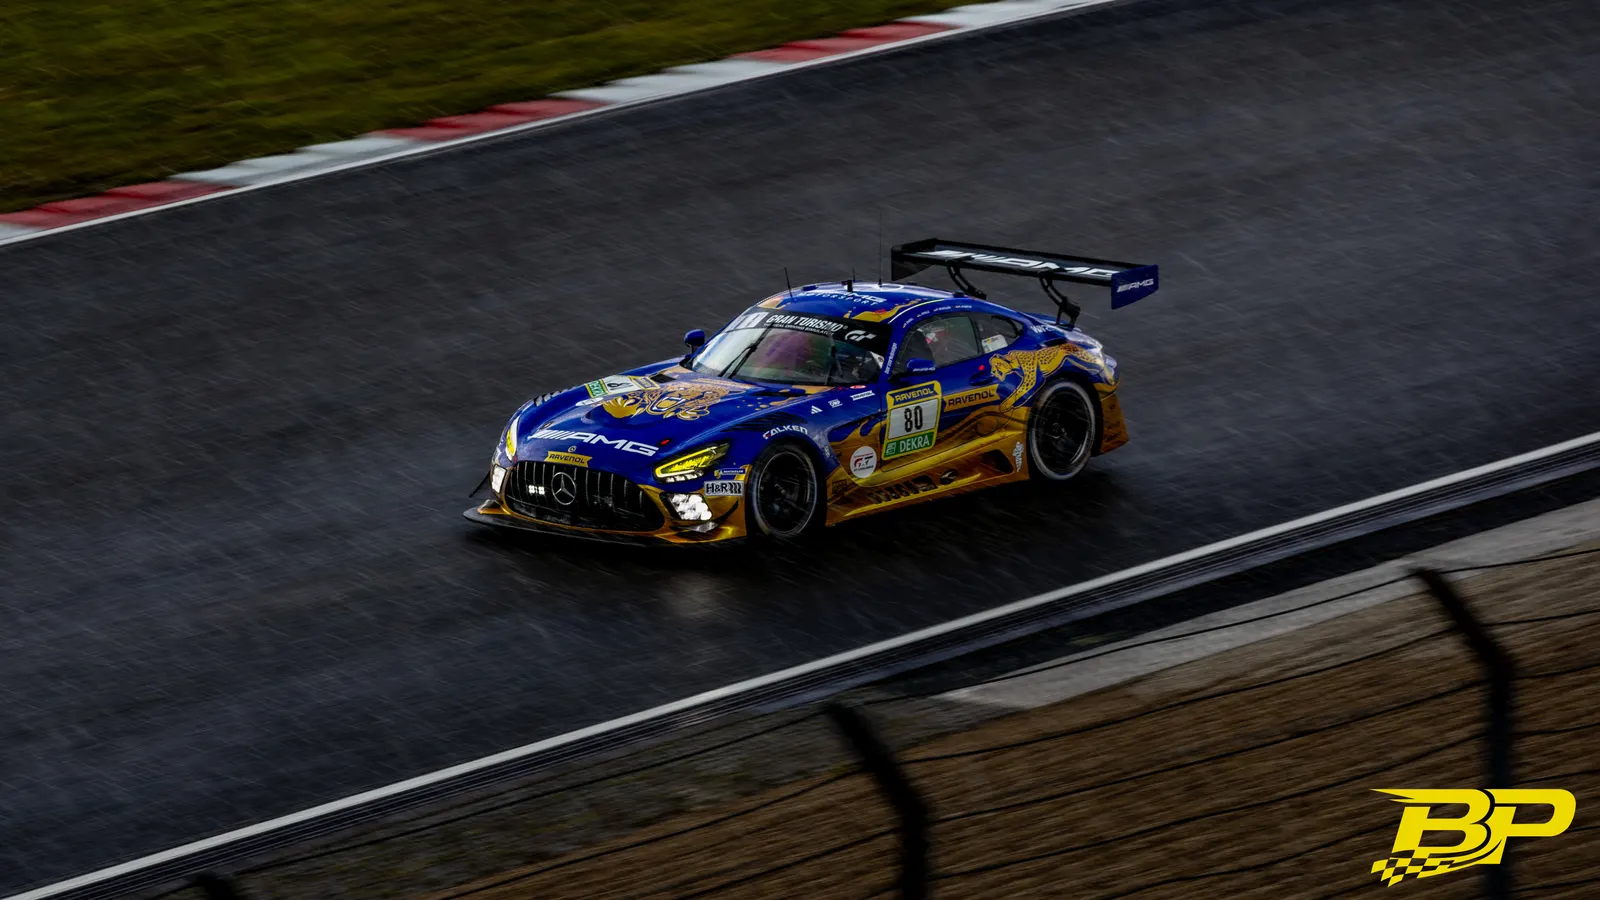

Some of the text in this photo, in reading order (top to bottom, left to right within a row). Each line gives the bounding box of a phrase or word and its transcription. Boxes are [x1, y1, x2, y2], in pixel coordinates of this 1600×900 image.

[765, 314, 844, 332] GRAN TURISMO
[894, 387, 935, 403] RAVENOL
[948, 389, 995, 407] RAVENOL
[903, 405, 923, 433] 80
[762, 424, 809, 441] FALKEN
[566, 431, 660, 457] AMG
[899, 435, 931, 453] DEKRA
[549, 452, 586, 465] RAVENOL
[706, 482, 728, 494] H&R
